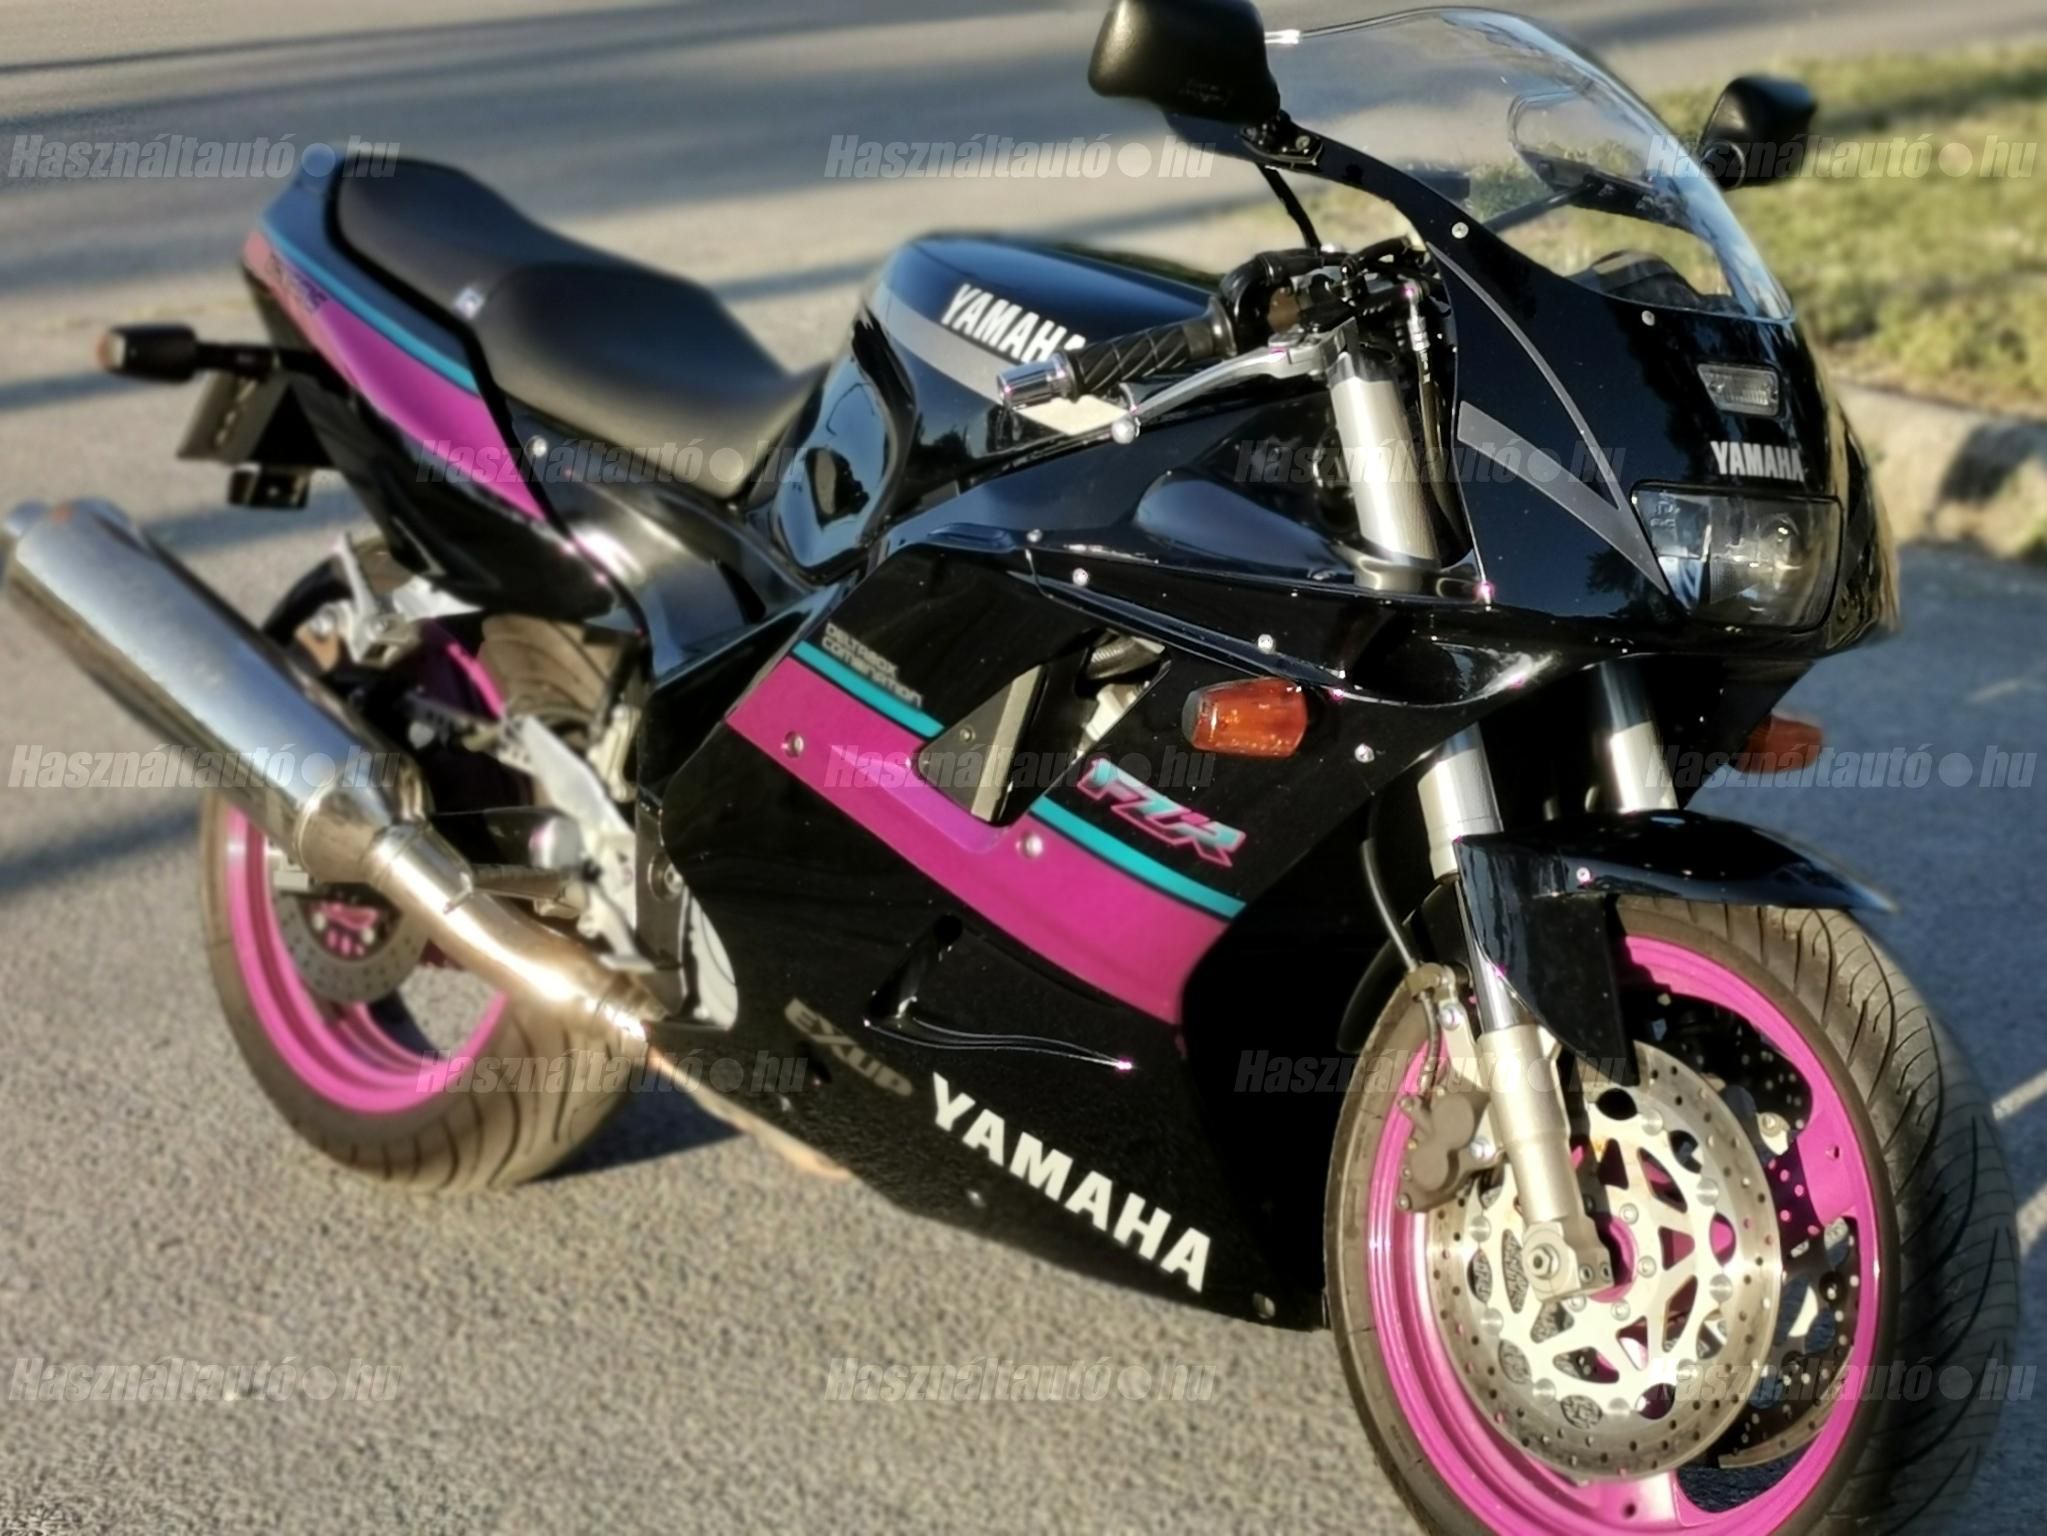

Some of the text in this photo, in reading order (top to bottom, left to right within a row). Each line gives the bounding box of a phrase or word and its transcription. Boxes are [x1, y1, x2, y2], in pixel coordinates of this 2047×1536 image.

[1709, 440, 1805, 482] YAMAHA
[1076, 757, 1247, 868] FZR
[784, 997, 913, 1097] EXUP
[932, 1071, 1211, 1293] YAMAHA
